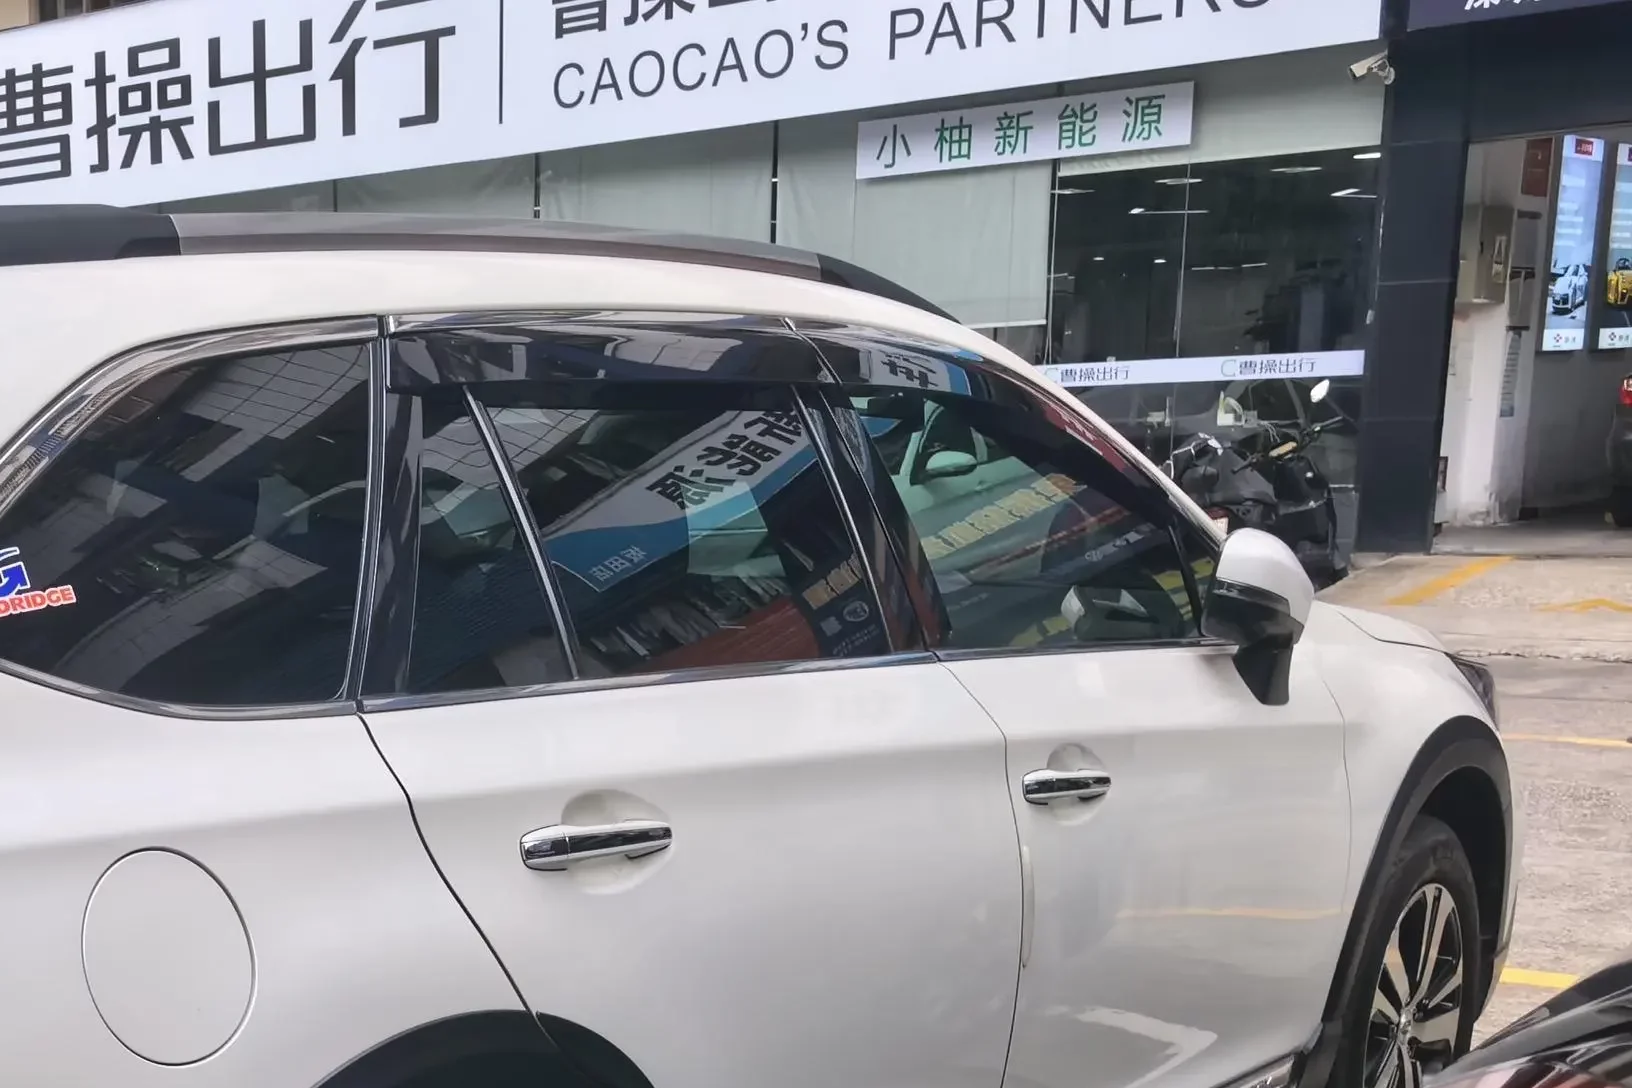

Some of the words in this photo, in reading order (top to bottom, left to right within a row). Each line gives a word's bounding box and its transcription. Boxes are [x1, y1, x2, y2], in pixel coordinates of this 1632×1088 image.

[553, 20, 849, 109] CAOCAO'S
[888, 0, 1272, 60] PARTN
[876, 94, 1166, 169] 小柚新能源
[1060, 364, 1131, 383] 曹操出行
[1239, 357, 1317, 376] 曹操出行
